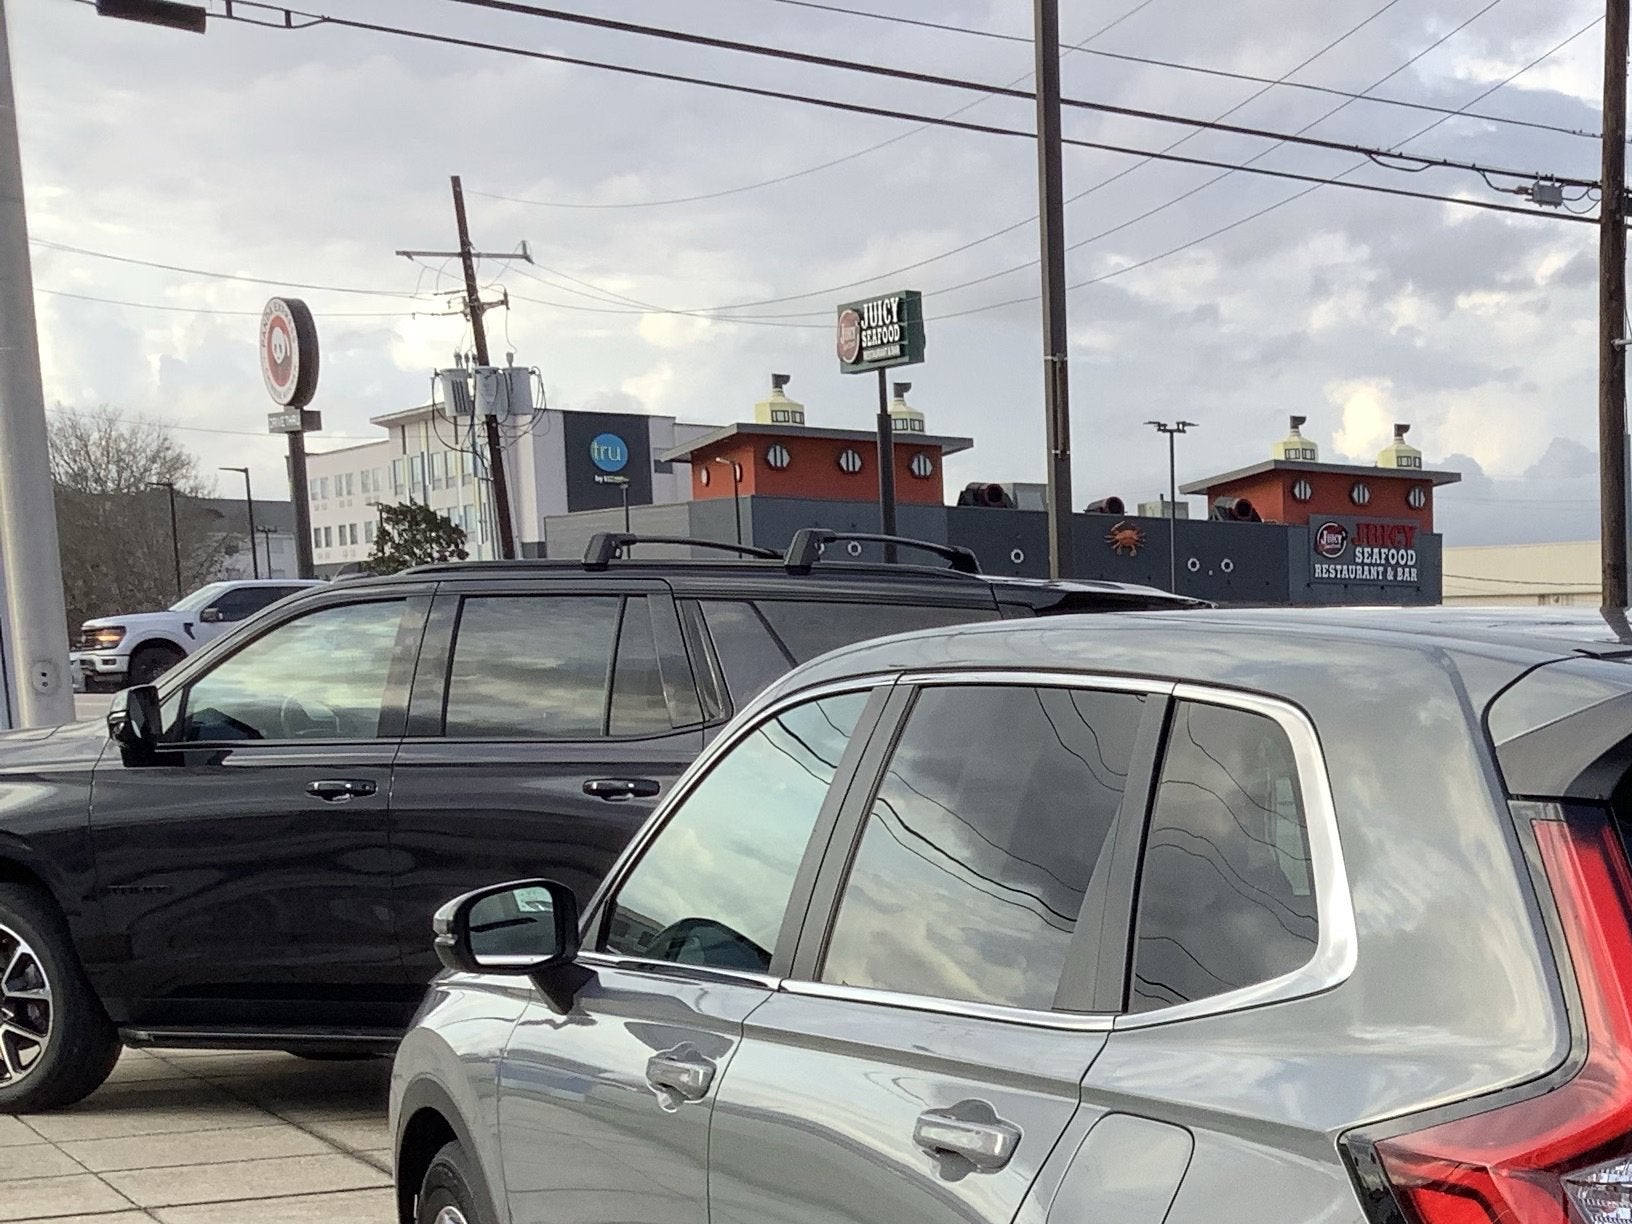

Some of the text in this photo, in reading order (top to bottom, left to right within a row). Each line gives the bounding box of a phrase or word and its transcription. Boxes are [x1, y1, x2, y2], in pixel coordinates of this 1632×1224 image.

[861, 297, 899, 329] JUICY
[861, 324, 900, 348] SEAFOOD
[592, 441, 621, 461] tru
[1352, 523, 1417, 548] JUICY
[1355, 547, 1416, 566] SEAFOOD
[1314, 564, 1418, 581] RESTAURANT & BAR
